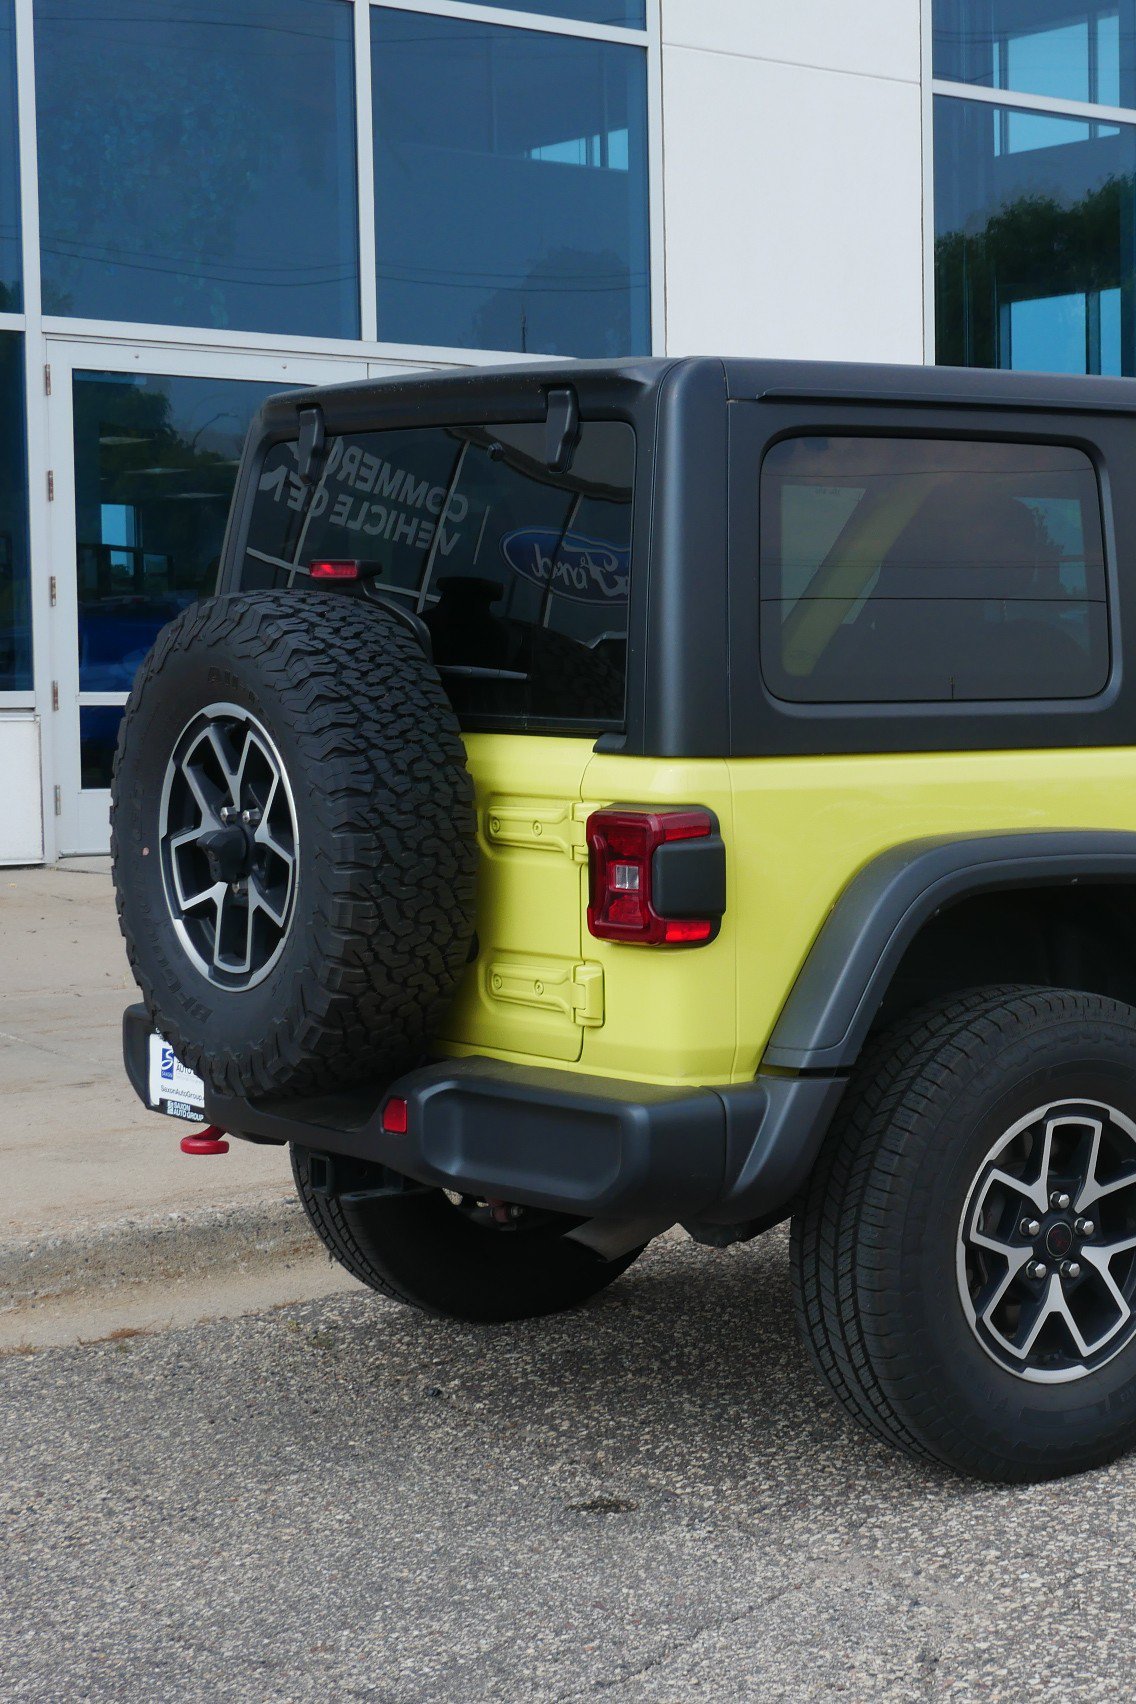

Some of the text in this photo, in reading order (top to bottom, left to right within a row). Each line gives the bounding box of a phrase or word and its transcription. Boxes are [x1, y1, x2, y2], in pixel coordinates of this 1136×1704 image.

[173, 1101, 191, 1112] SAXON
[173, 1107, 204, 1122] AUTO GROUP
